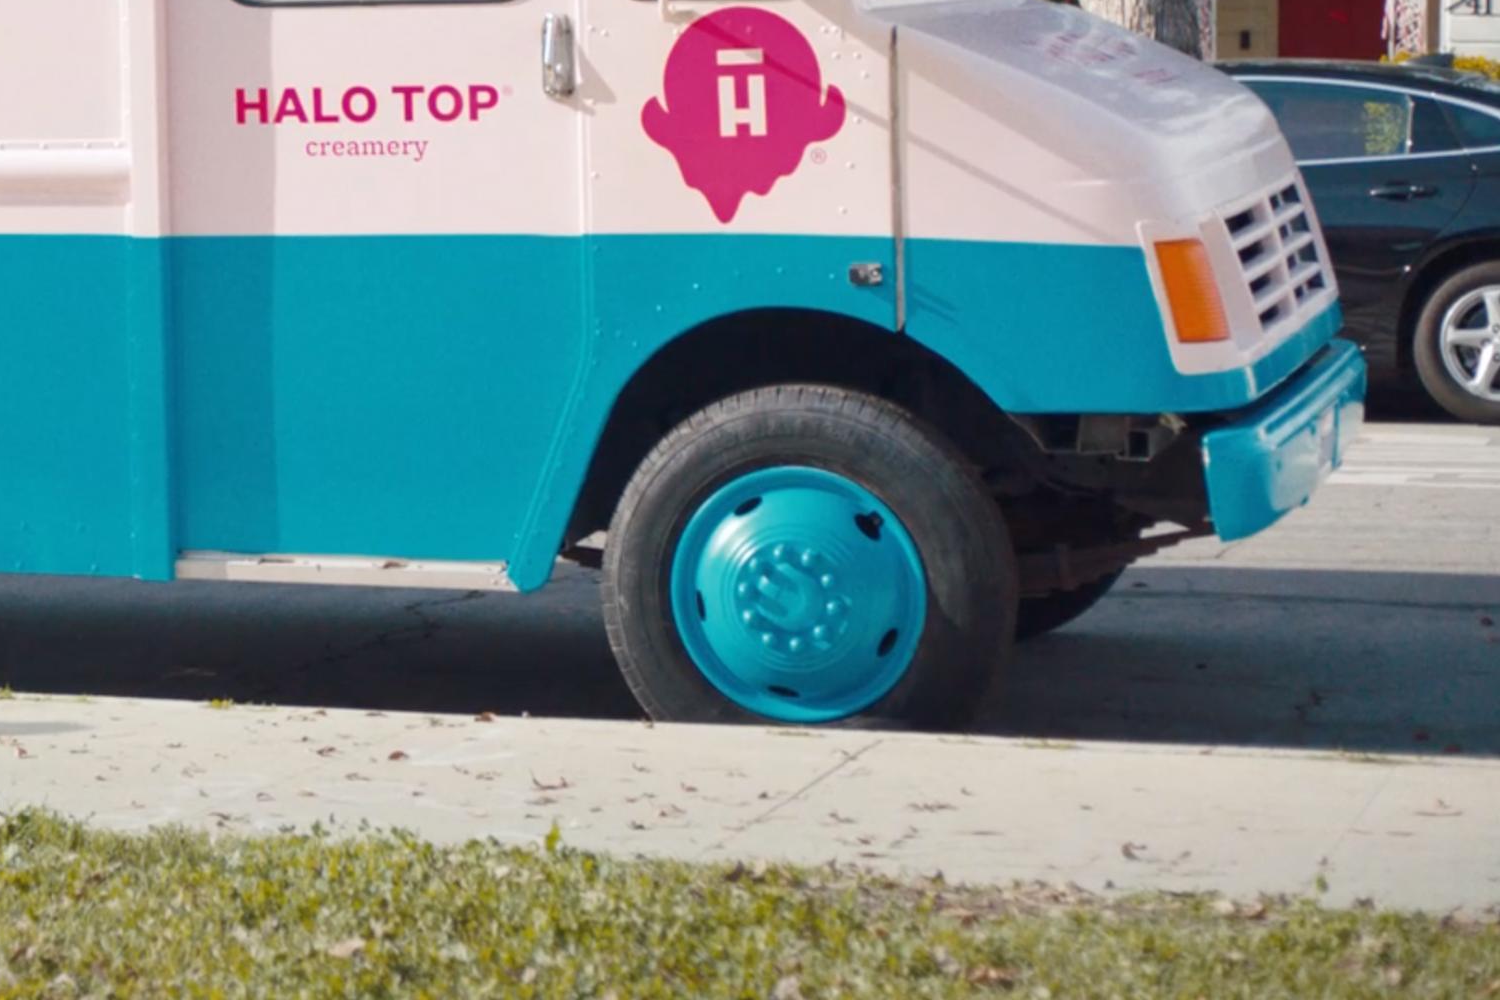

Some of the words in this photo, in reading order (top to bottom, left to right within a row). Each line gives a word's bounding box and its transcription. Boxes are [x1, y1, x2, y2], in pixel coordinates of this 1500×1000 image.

[234, 86, 378, 124] HALO
[392, 85, 500, 122] TOP
[304, 139, 429, 162] creamery
